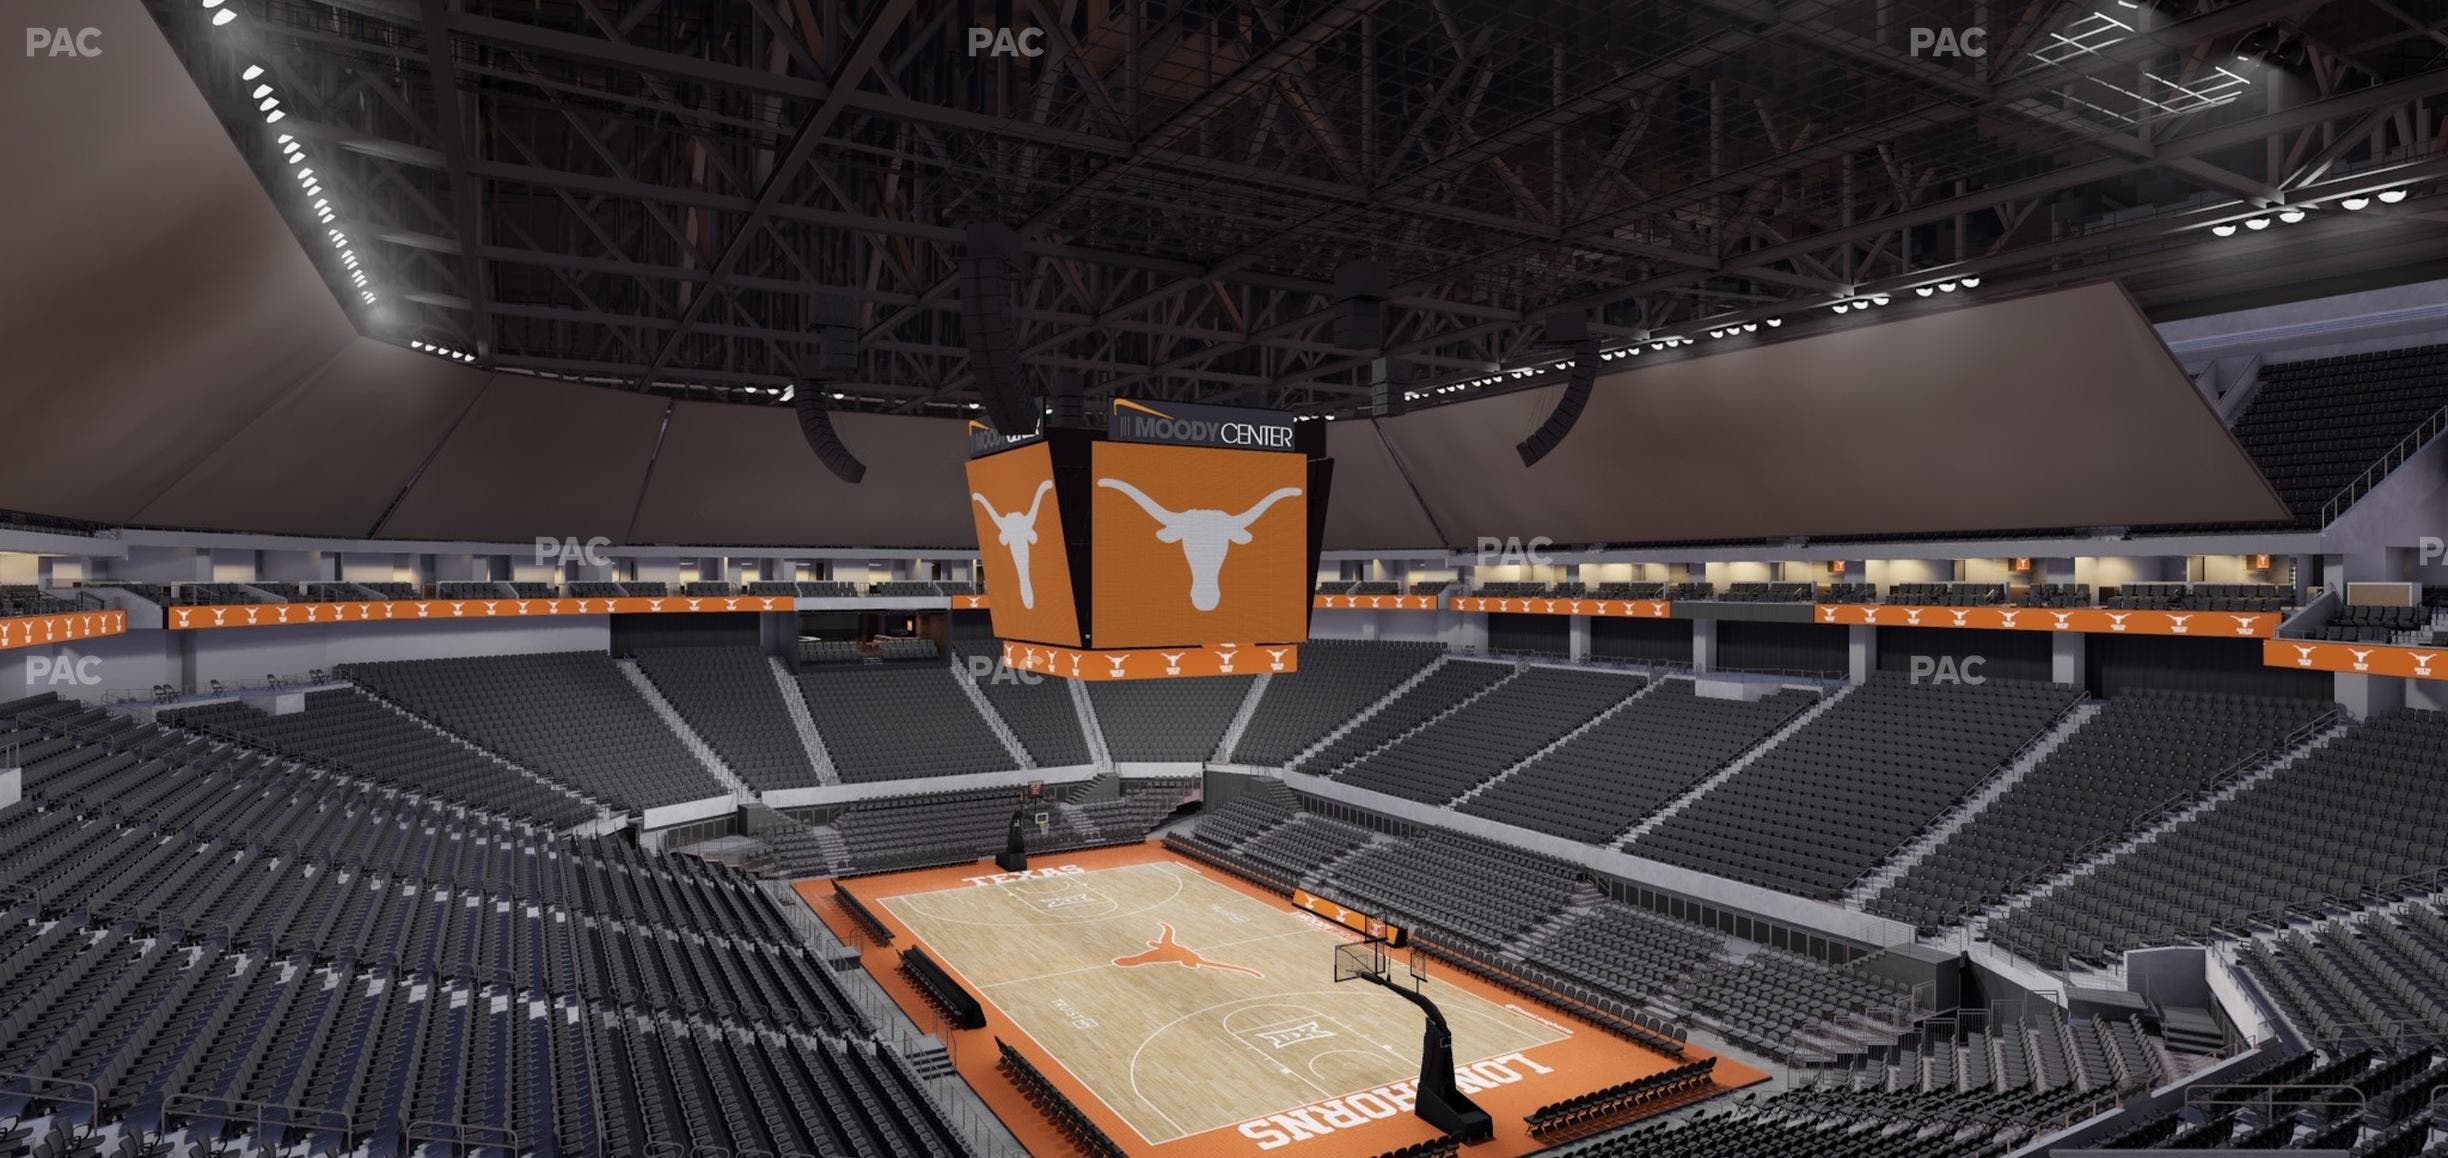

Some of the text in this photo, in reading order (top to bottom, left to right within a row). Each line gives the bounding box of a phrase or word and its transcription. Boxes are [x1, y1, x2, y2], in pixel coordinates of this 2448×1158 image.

[1135, 416, 1293, 447] MOODY CENTER
[961, 864, 1086, 888] TEXAS
[1237, 1052, 1554, 1151] LONHORNS
